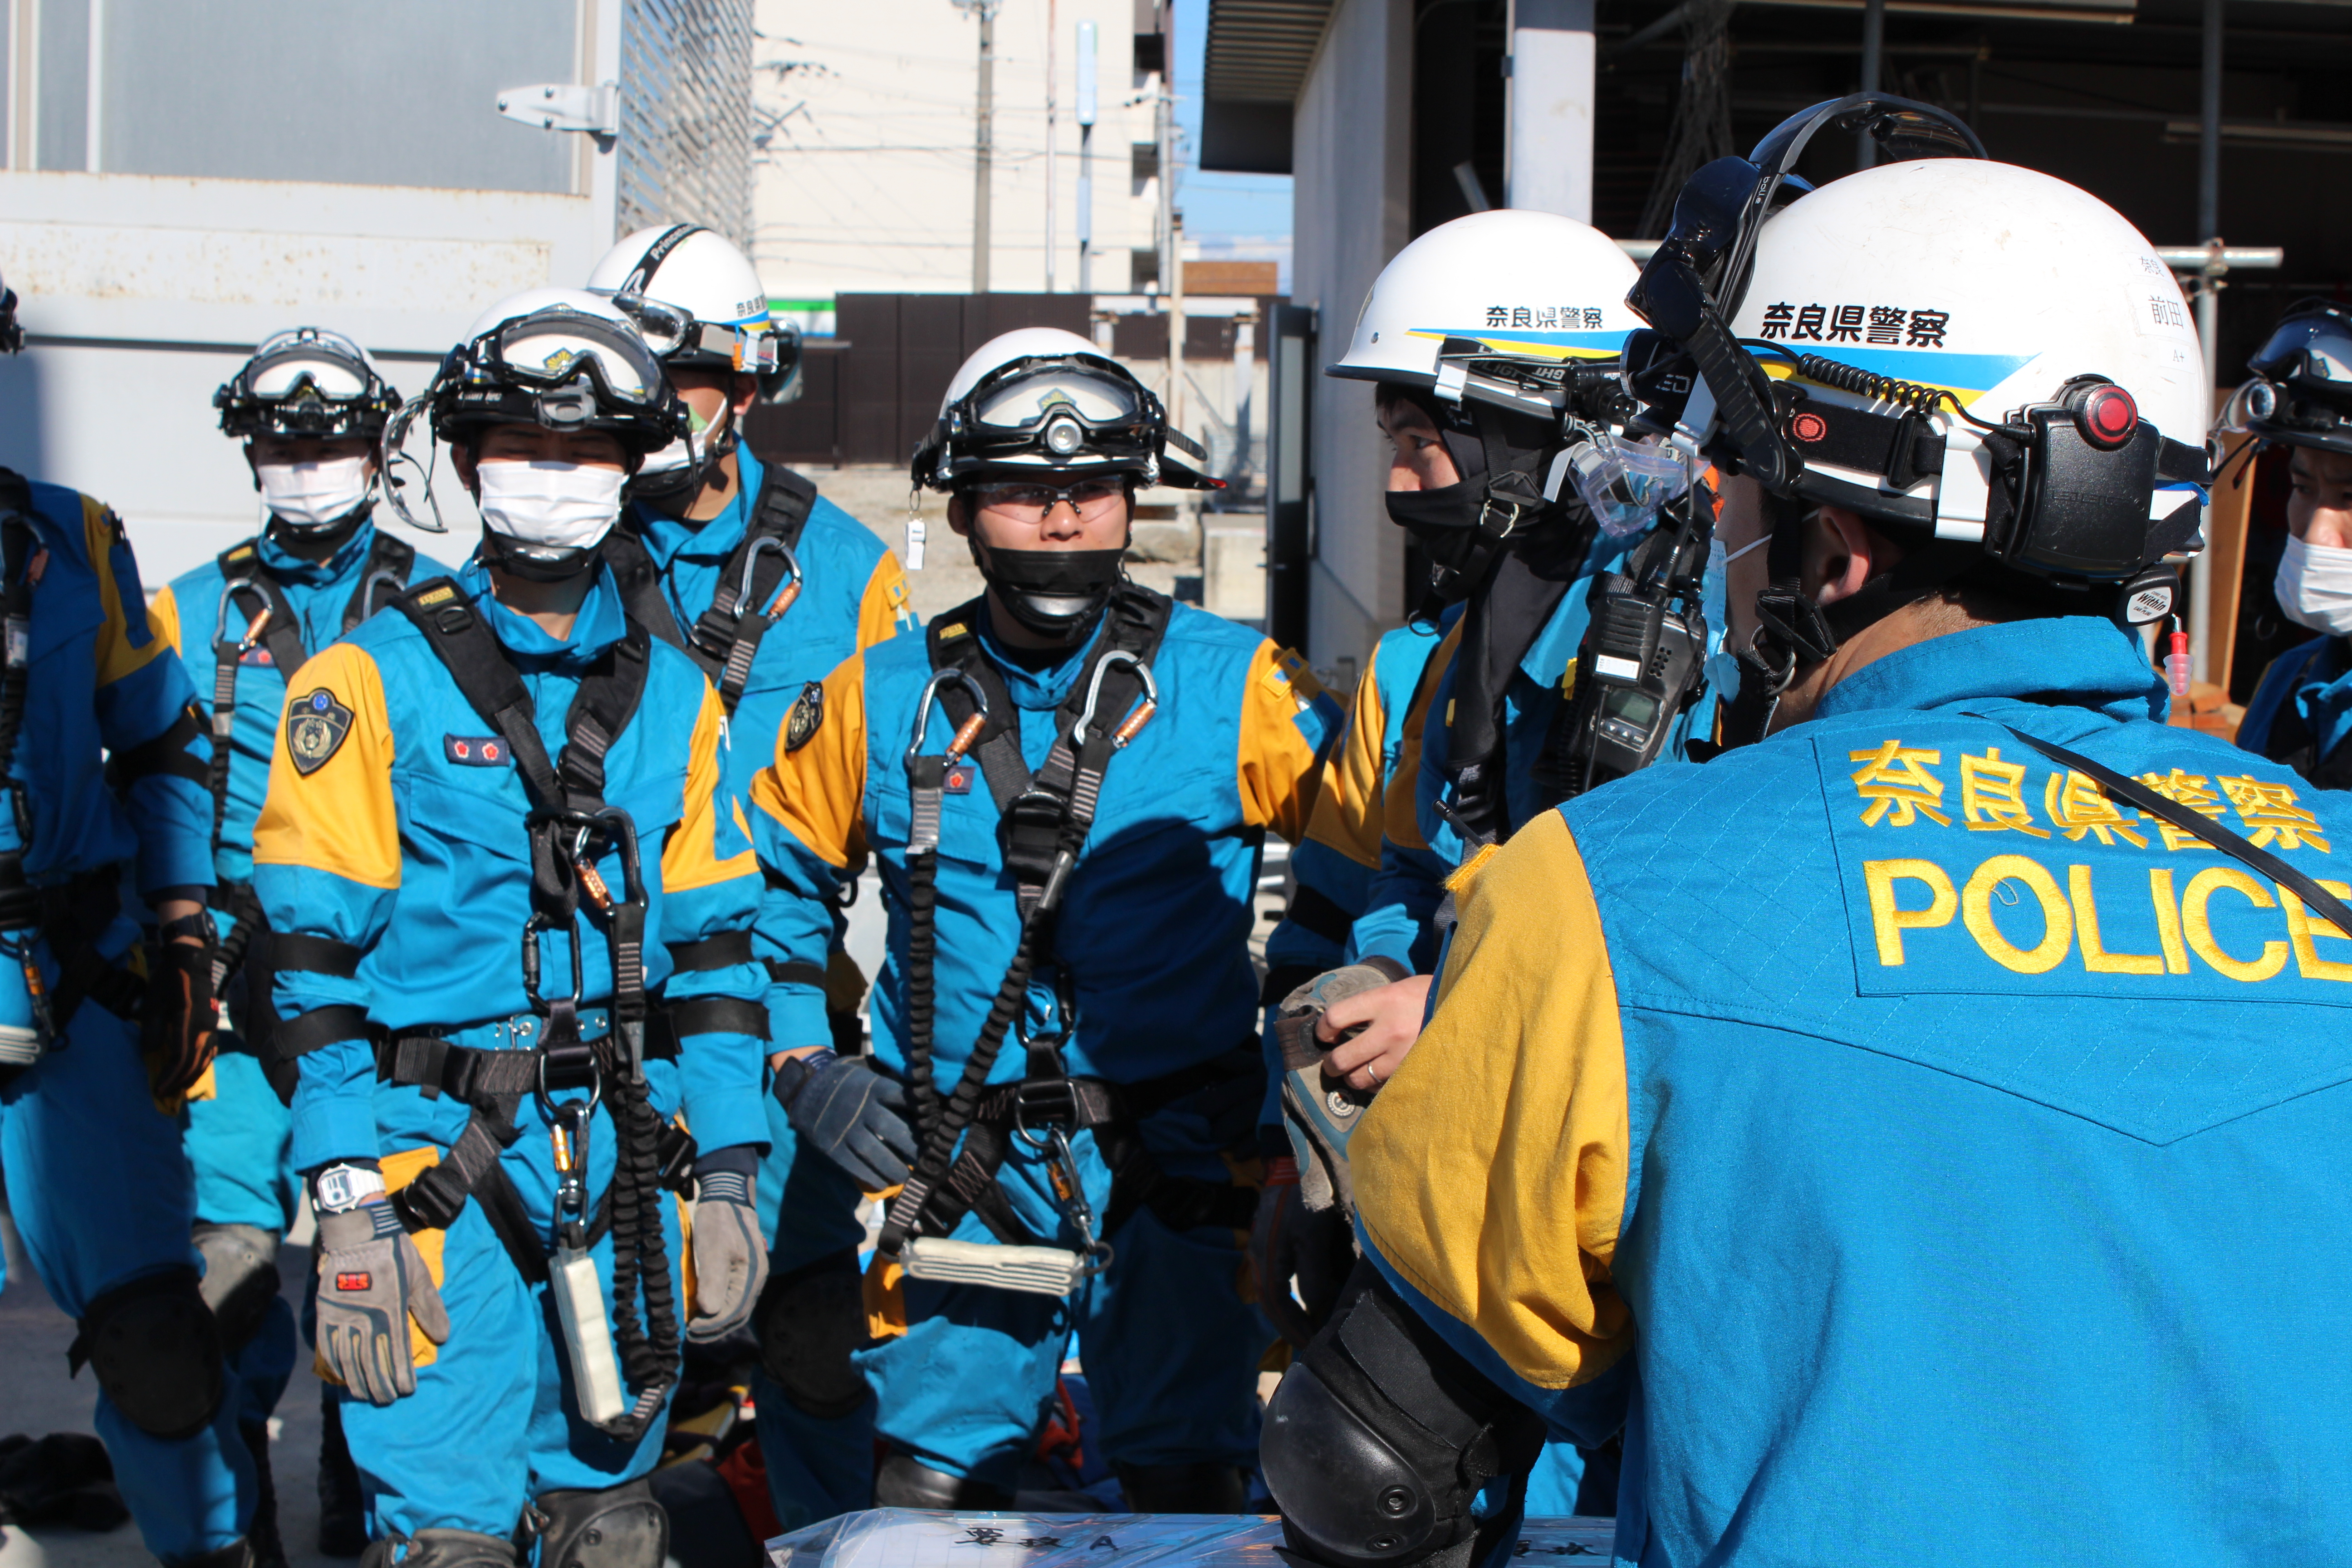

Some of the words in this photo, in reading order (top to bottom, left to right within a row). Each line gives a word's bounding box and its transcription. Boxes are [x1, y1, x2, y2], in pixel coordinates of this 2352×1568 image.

[1486, 305, 1603, 329] 奈良県警察
[1759, 301, 1950, 348] 奈良県警察
[2148, 294, 2184, 330] 前田
[1848, 739, 2331, 854] 奈良県警察
[1862, 854, 2352, 982] POLICE
